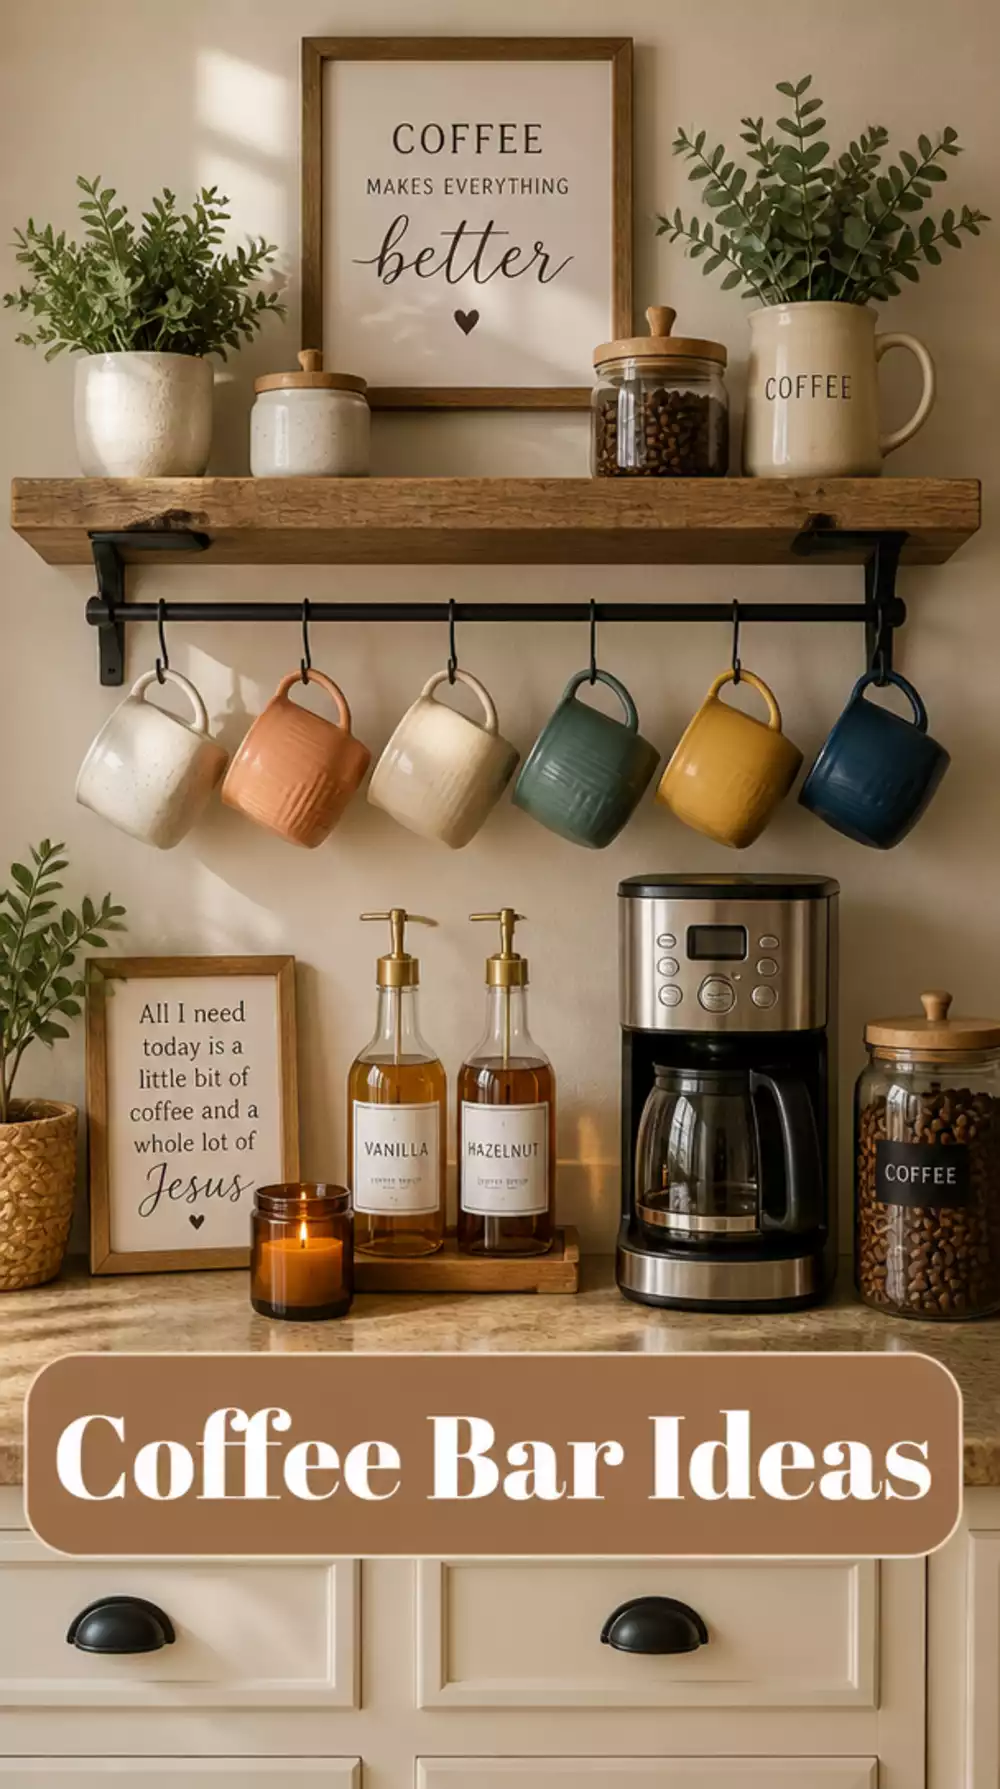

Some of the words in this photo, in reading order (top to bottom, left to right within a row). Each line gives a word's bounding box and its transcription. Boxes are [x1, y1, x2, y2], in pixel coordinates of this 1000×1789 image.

[392, 122, 543, 154] COFFEE
[366, 177, 434, 195] MAKES
[444, 177, 569, 195] EVERYTHING
[352, 214, 575, 285] better
[765, 374, 852, 401] COFFEE
[139, 1003, 169, 1024] All
[178, 1003, 186, 1023] I
[194, 1000, 246, 1023] need
[143, 1036, 201, 1061] today
[209, 1036, 225, 1056] is
[232, 1040, 243, 1055] a
[139, 1069, 187, 1089] little
[195, 1068, 222, 1087] bit
[229, 1066, 250, 1087] of
[130, 1100, 194, 1122] coffee
[201, 1099, 240, 1120] and
[247, 1104, 259, 1119] a
[134, 1132, 194, 1154] whole
[202, 1132, 228, 1152] lot
[235, 1130, 257, 1151] of
[364, 1142, 429, 1157] VANILLA
[468, 1141, 539, 1158] HAZELNUT
[884, 1163, 957, 1184] COFFEE
[138, 1162, 255, 1218] Jesus
